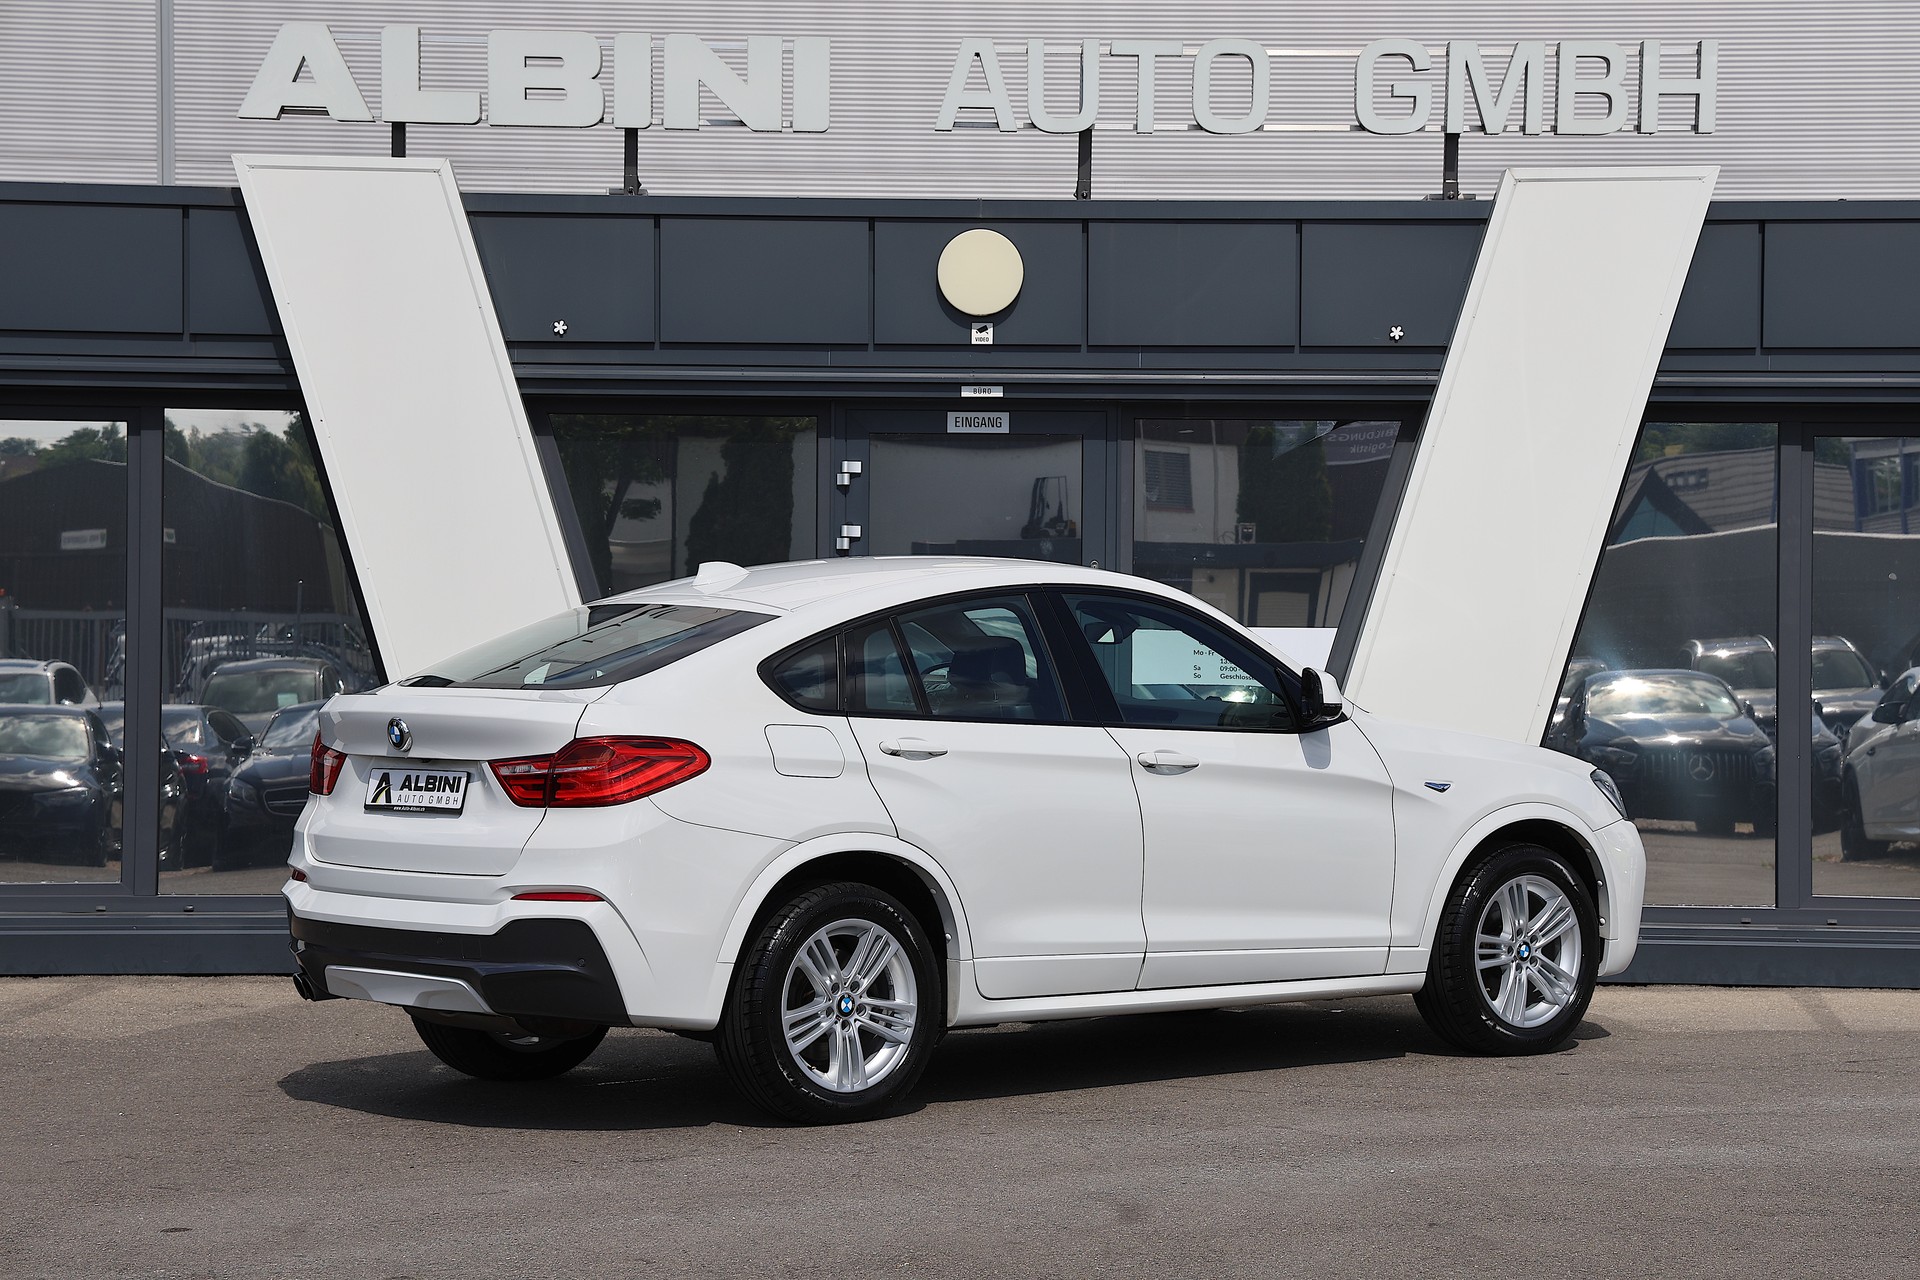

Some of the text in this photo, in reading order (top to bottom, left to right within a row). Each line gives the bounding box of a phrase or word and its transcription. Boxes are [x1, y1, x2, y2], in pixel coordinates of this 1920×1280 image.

[237, 22, 1720, 137] ALBINI AUTO GMBH
[954, 416, 1002, 429] EINGANG
[400, 774, 462, 793] ALBINI
[396, 794, 458, 805] AUTO GMBH
